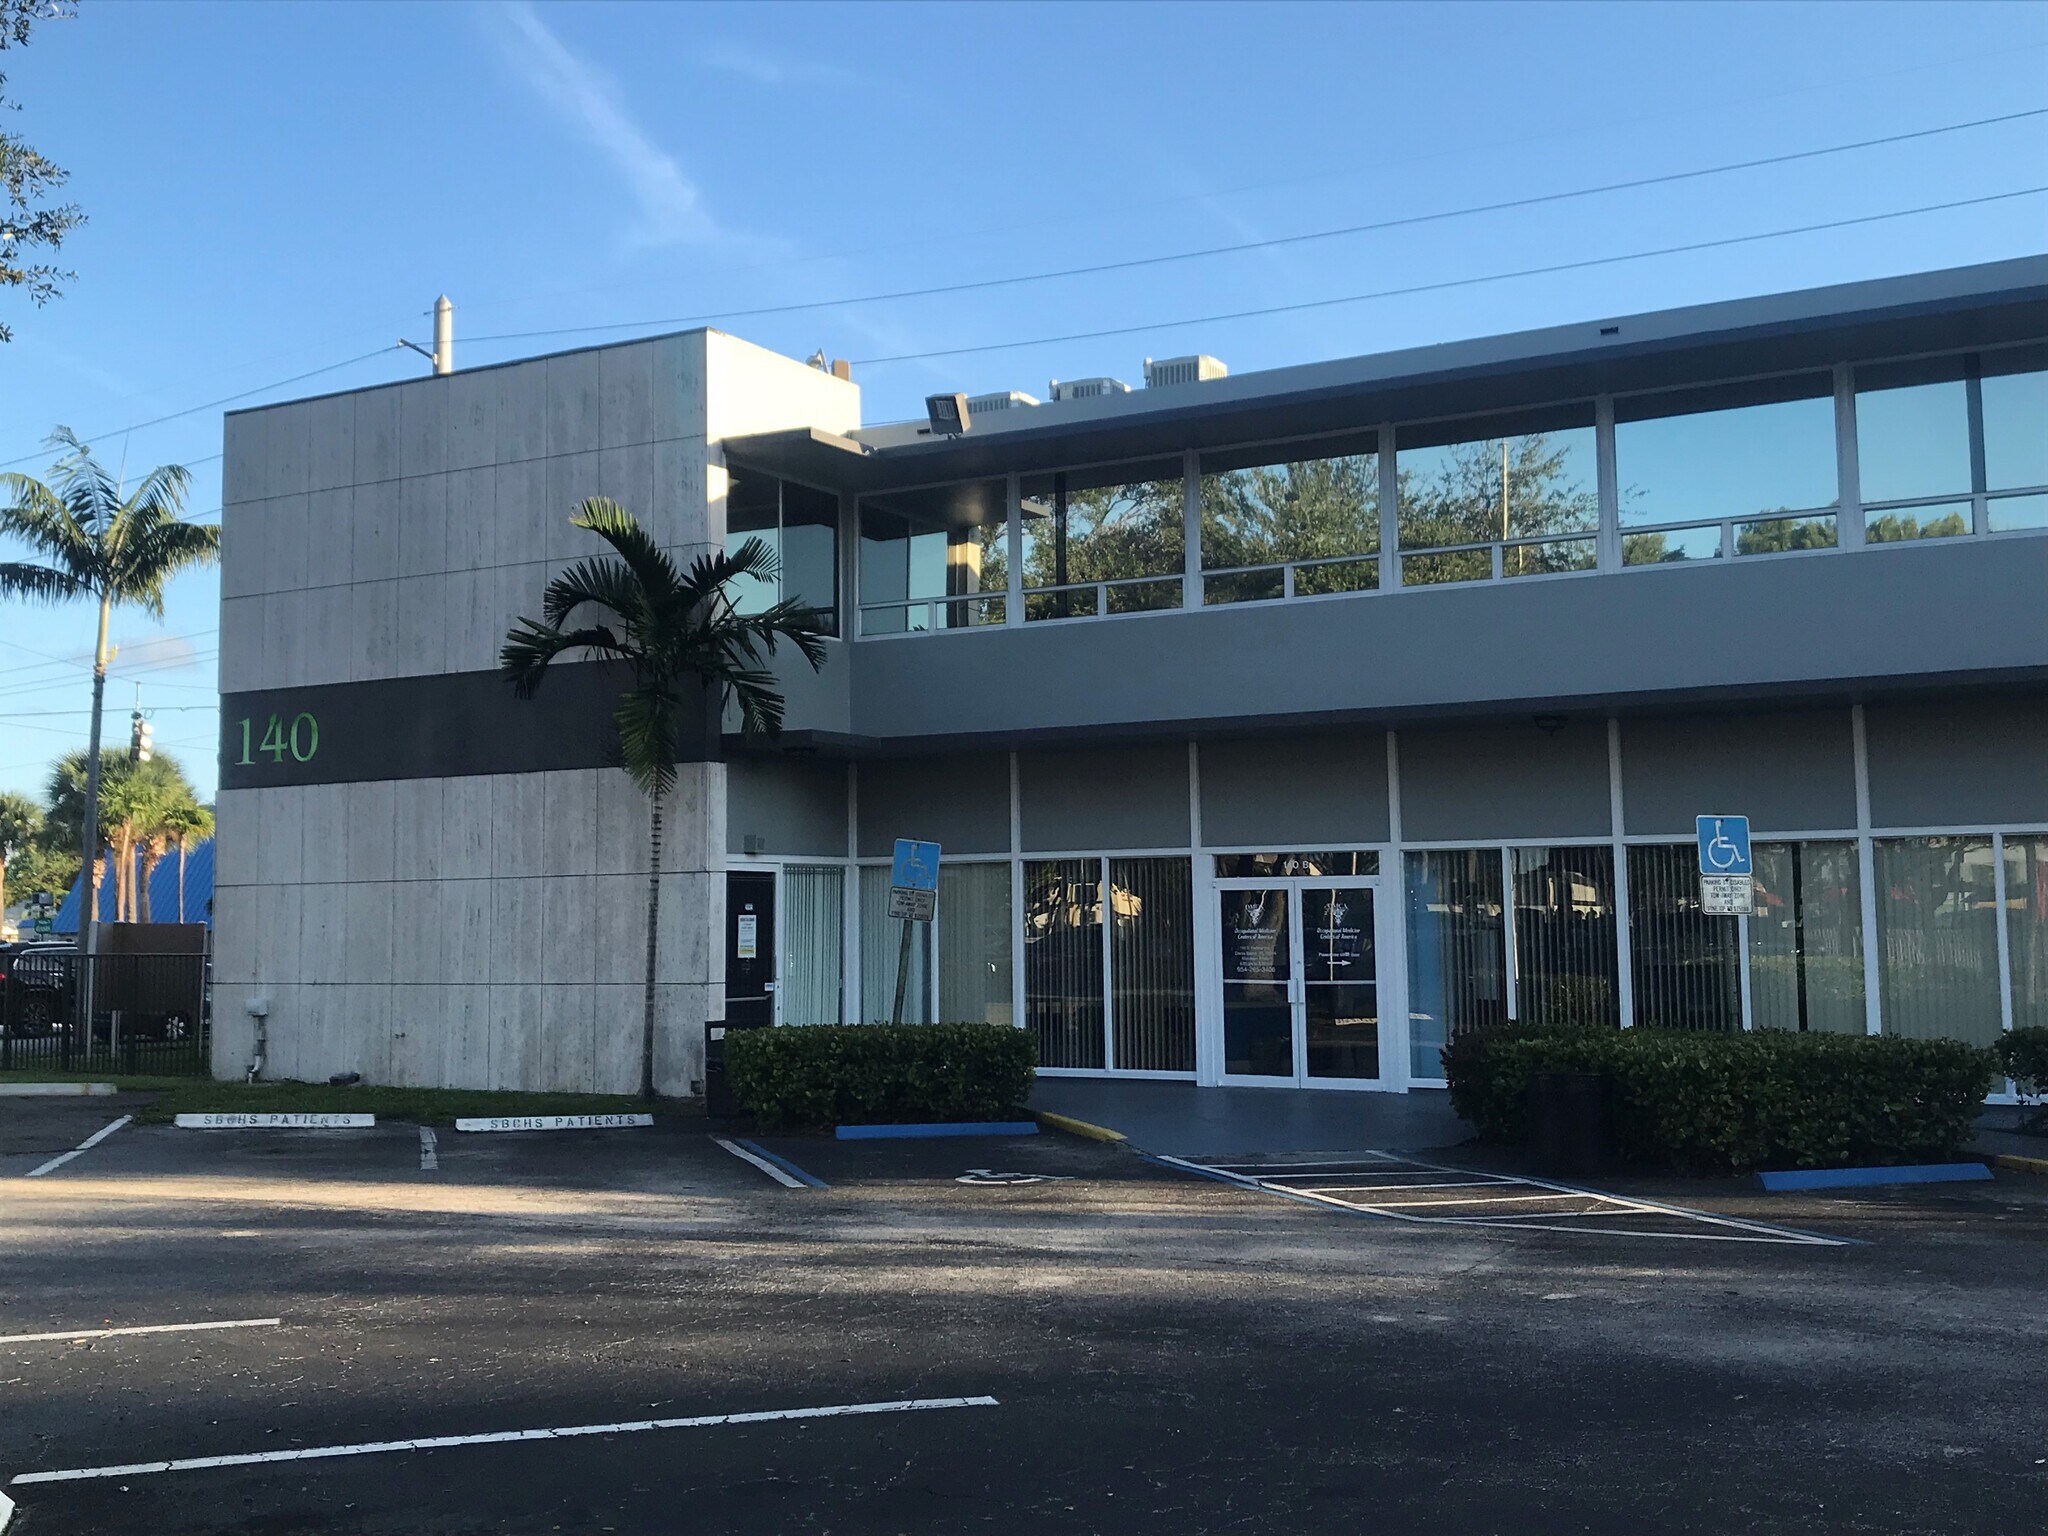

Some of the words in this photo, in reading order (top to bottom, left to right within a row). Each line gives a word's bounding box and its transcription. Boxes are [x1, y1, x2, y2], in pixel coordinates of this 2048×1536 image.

[234, 712, 319, 766] 140
[1302, 860, 1309, 869] B
[270, 1114, 351, 1125] PATIENTS
[491, 1118, 543, 1129] SBCHS
[556, 1115, 635, 1127] PATIENTS
